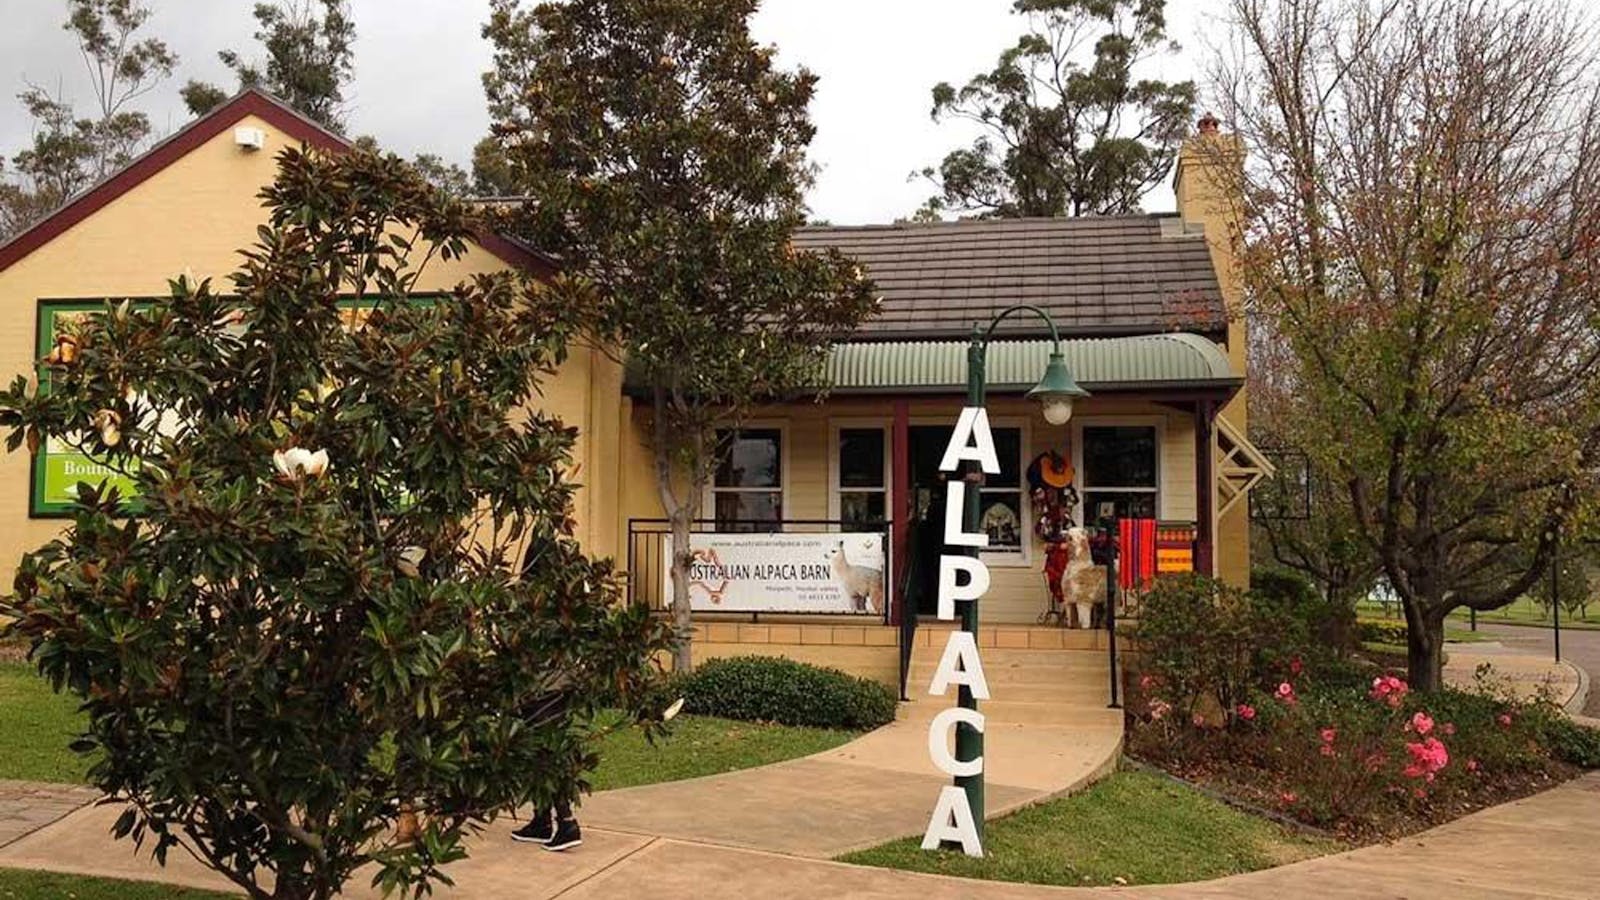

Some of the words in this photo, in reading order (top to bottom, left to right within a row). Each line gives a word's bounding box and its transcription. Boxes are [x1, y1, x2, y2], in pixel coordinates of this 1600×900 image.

[689, 564, 750, 580] USTRALIAN
[753, 564, 797, 580] ALPACA
[801, 564, 831, 580] BARN
[920, 406, 1001, 858] ALPACA
